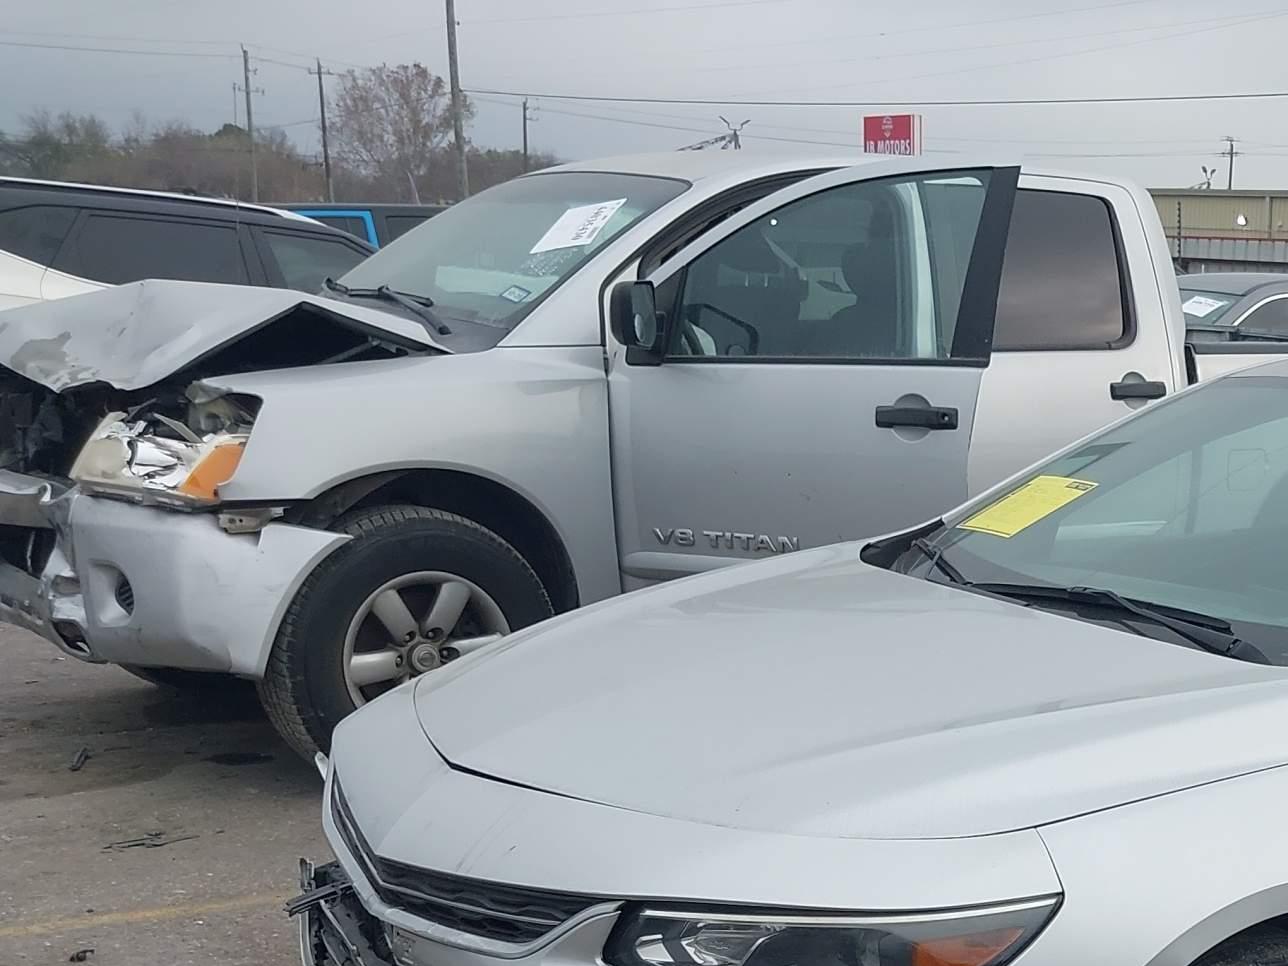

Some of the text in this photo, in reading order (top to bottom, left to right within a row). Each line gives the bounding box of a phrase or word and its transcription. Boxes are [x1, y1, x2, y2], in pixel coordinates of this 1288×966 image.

[877, 139, 911, 155] MOTORS
[653, 528, 799, 552] V8 TITAN
